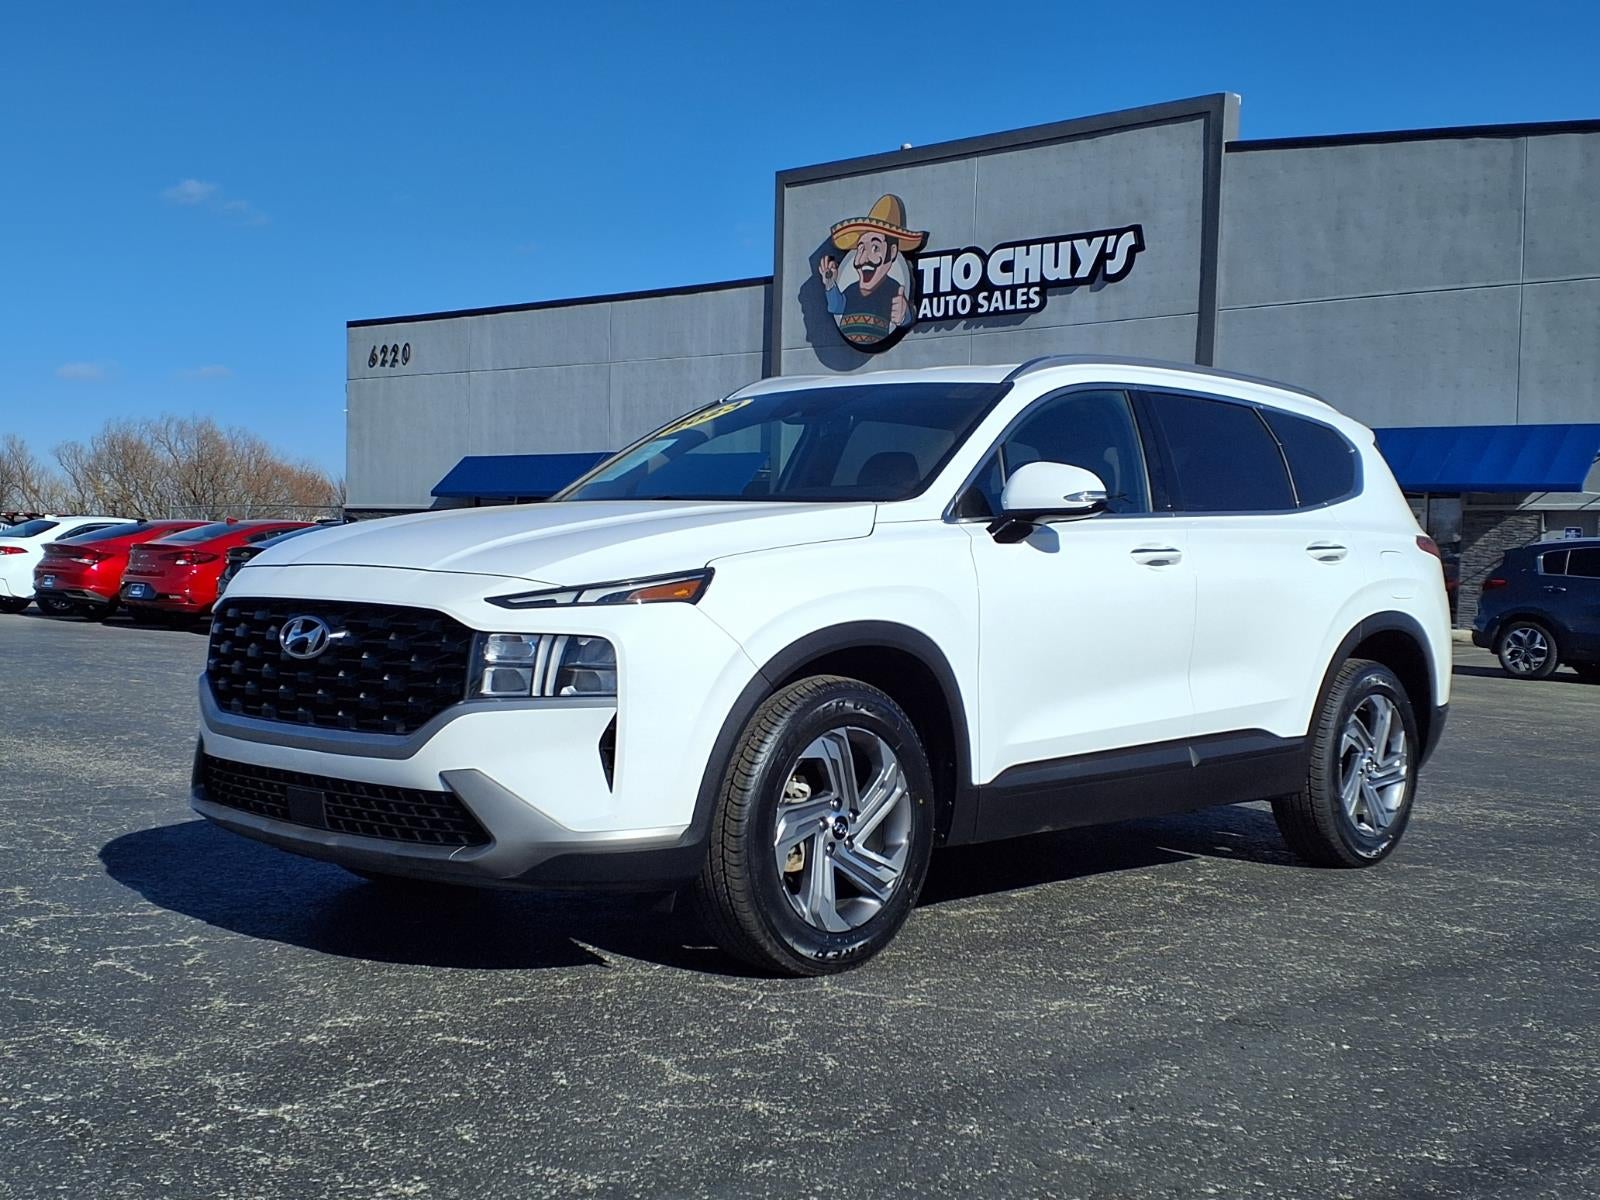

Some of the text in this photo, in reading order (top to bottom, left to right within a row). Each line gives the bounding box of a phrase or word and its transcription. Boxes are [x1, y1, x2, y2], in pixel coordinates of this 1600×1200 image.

[917, 230, 1135, 294] TIO CHUY'S
[918, 286, 1040, 319] AUTO SALES
[367, 342, 411, 368] 6220
